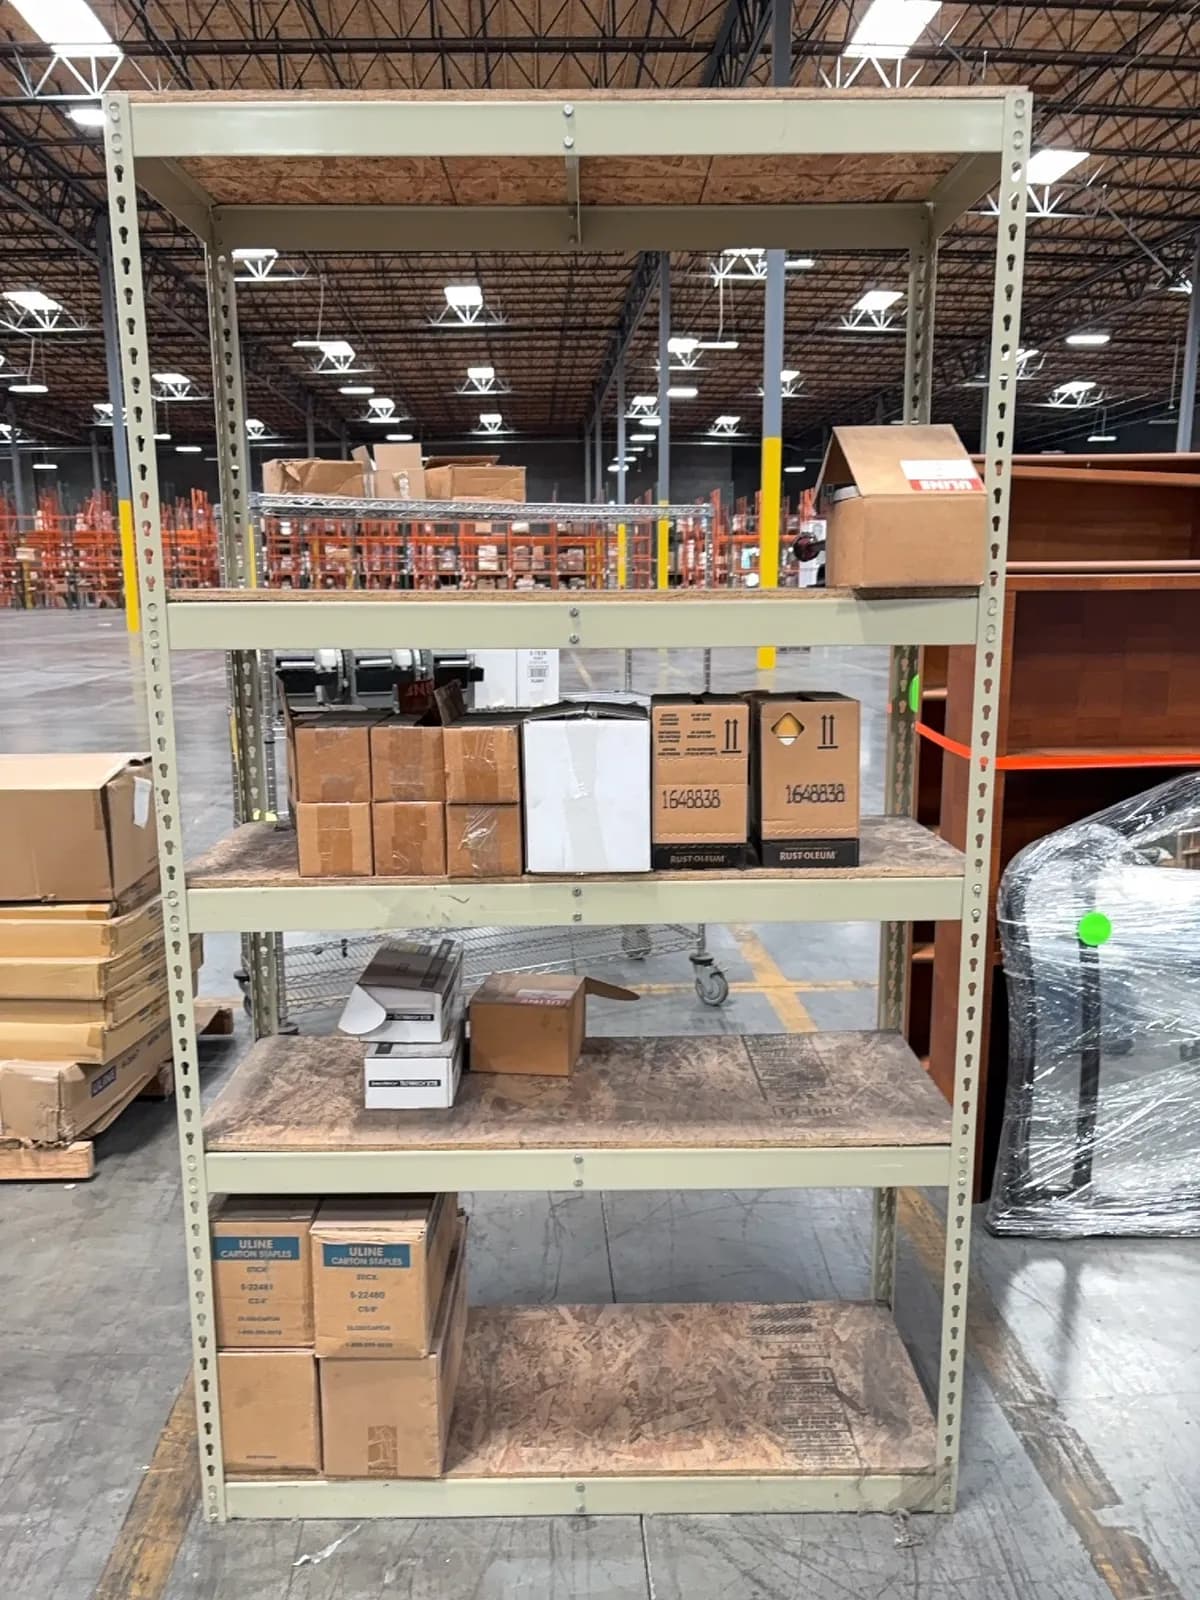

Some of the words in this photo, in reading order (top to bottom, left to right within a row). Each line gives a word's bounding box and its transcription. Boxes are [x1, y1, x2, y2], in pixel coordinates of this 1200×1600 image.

[785, 784, 845, 804] 1648838
[662, 789, 721, 809] 1648838
[239, 1240, 273, 1249] ULINE
[220, 1250, 258, 1258] CARTON
[259, 1250, 292, 1258] STAPLES
[349, 1247, 384, 1256] ULINE
[331, 1257, 367, 1265] CARTON
